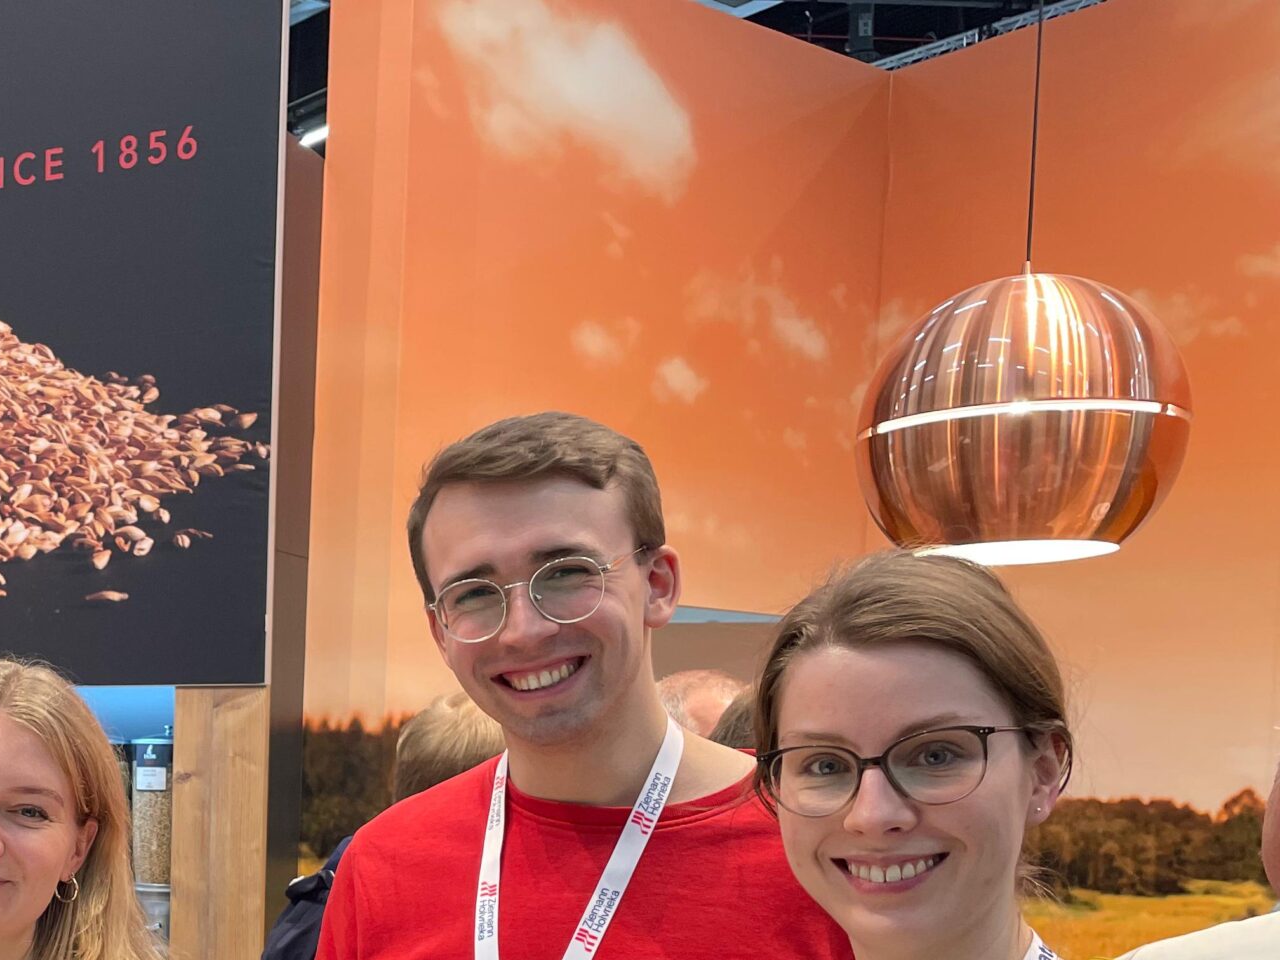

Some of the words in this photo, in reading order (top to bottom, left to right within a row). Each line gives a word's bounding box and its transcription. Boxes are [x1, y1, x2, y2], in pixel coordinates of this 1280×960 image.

[91, 125, 199, 173] 1856
[638, 772, 662, 812] Ziemann
[582, 887, 610, 929] Ziemann
[592, 890, 620, 933] Holvrieka
